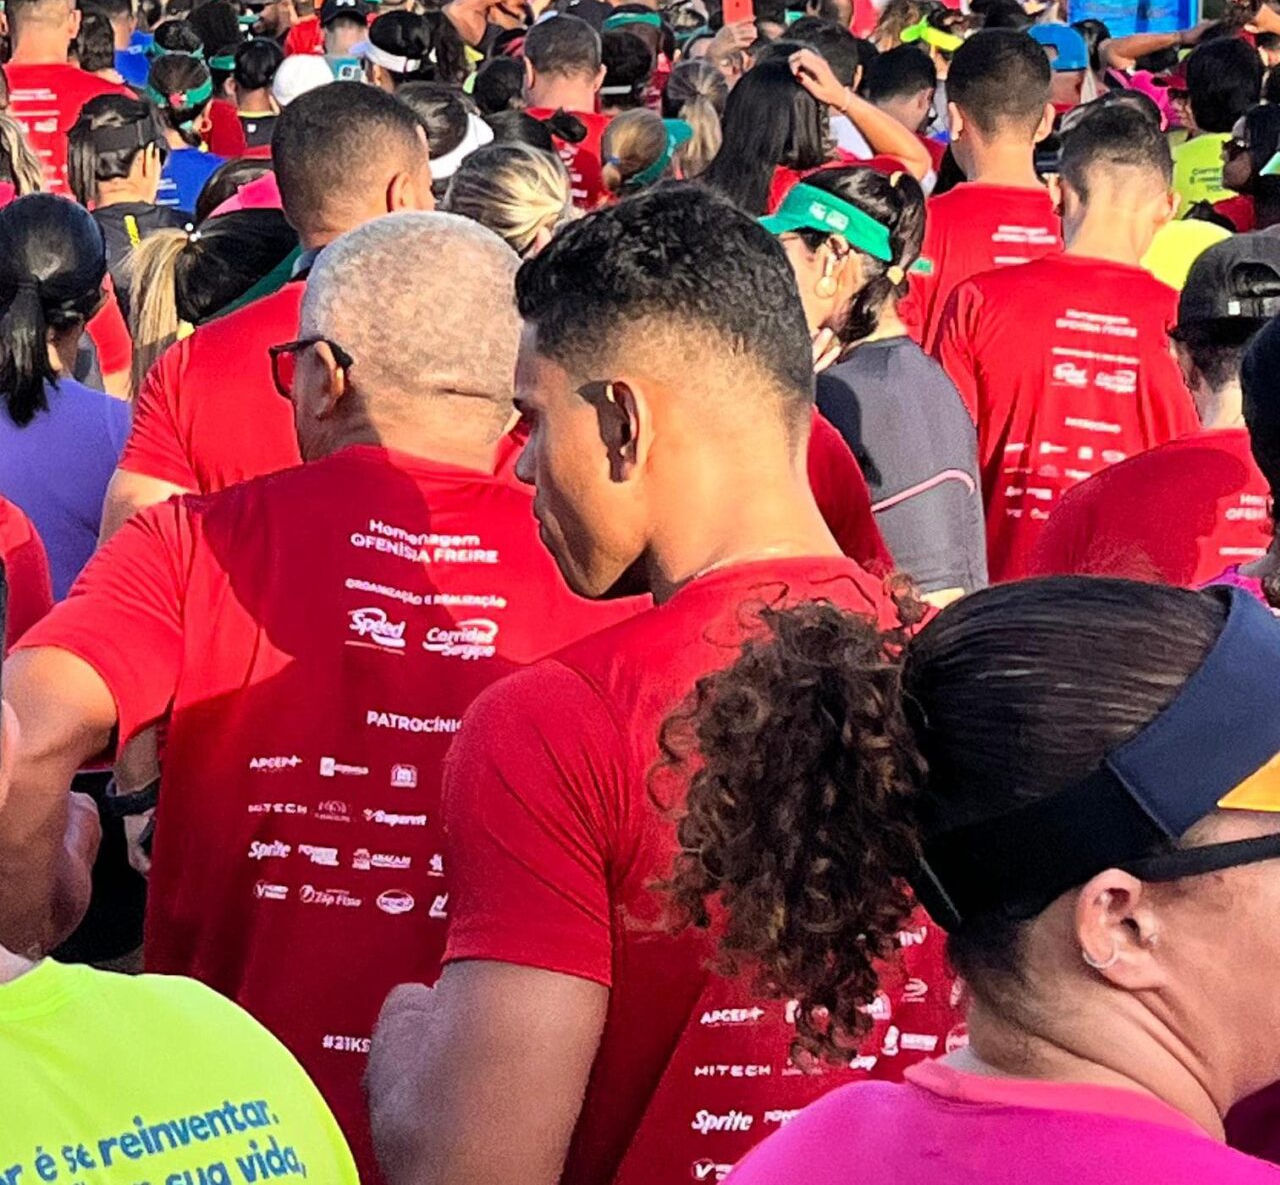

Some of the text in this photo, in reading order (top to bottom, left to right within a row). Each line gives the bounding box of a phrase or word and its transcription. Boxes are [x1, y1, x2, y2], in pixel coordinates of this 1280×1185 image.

[370, 519, 480, 547] Homenagem
[350, 532, 499, 563] OFENÍSIA FREIRE
[426, 626, 495, 645] Corridas
[248, 840, 291, 860] Sprite
[322, 1034, 372, 1053] #21KS
[694, 1065, 771, 1077] HITECH
[691, 1109, 754, 1135] Sprite
[35, 1146, 58, 1183] é
[98, 1100, 279, 1167] reinventar.
[235, 1134, 307, 1185] vida,
